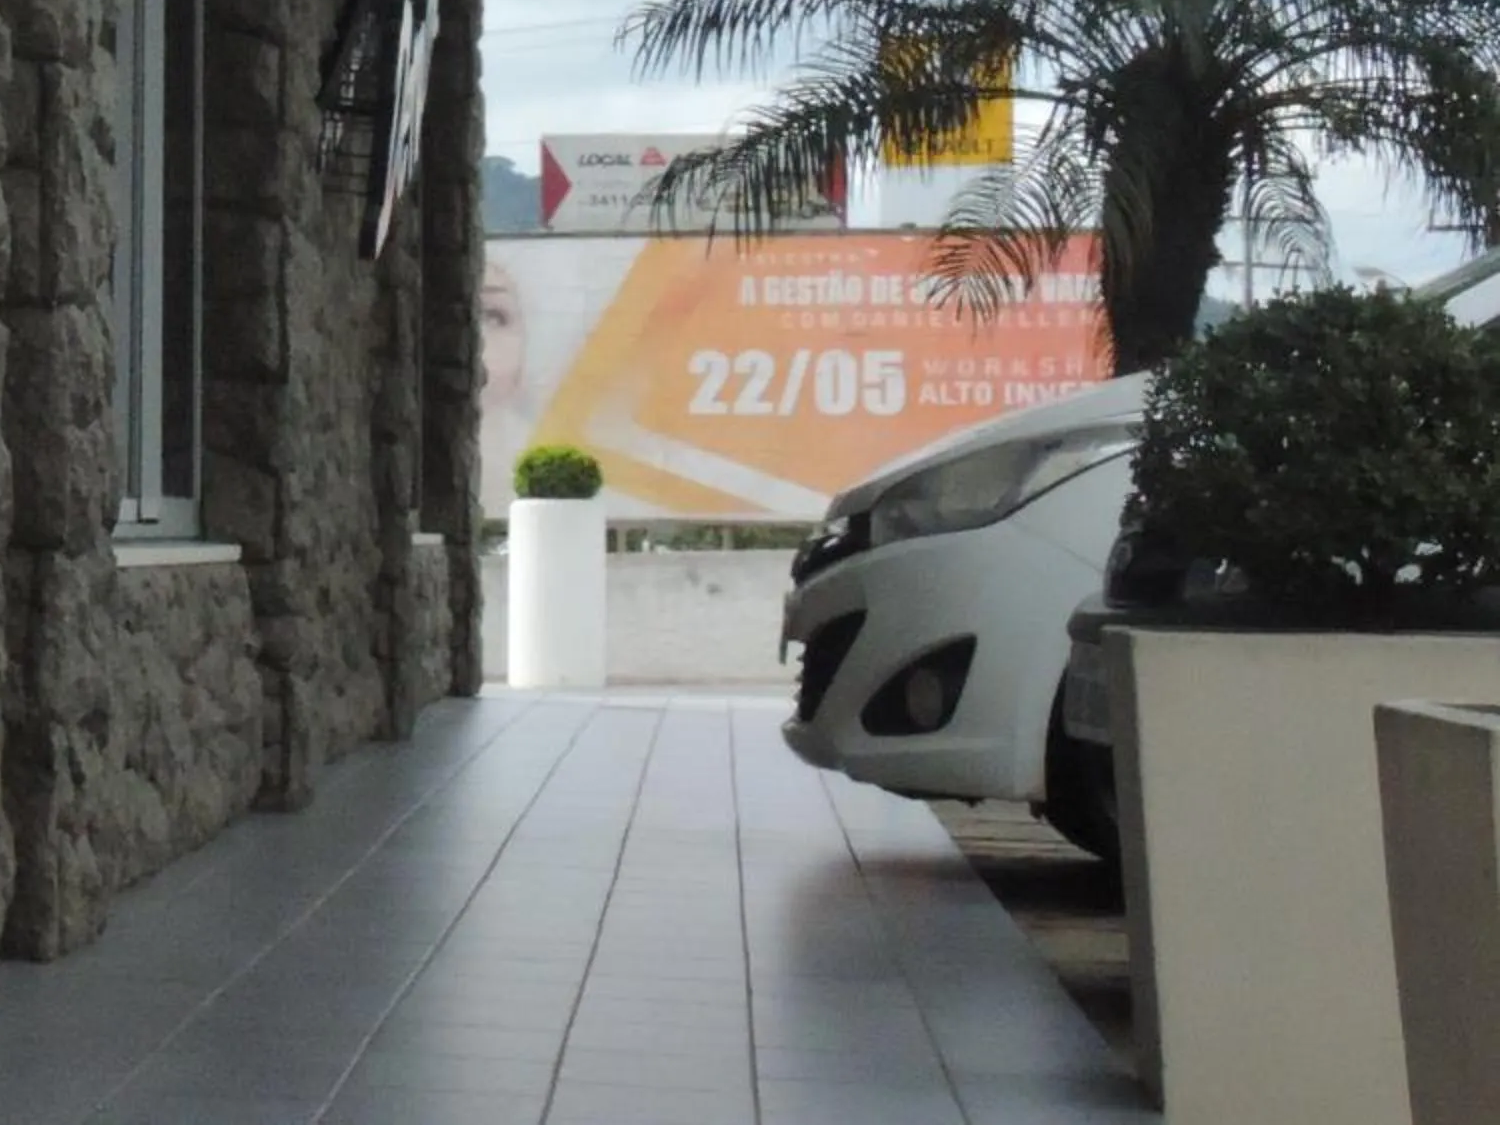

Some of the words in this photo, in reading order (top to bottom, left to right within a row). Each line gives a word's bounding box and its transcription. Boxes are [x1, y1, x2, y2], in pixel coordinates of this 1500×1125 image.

[739, 275, 757, 306] A
[763, 269, 863, 306] GESTÃO
[870, 275, 903, 306] DE
[687, 348, 907, 416] 22/05
[919, 381, 994, 406] ALTO
